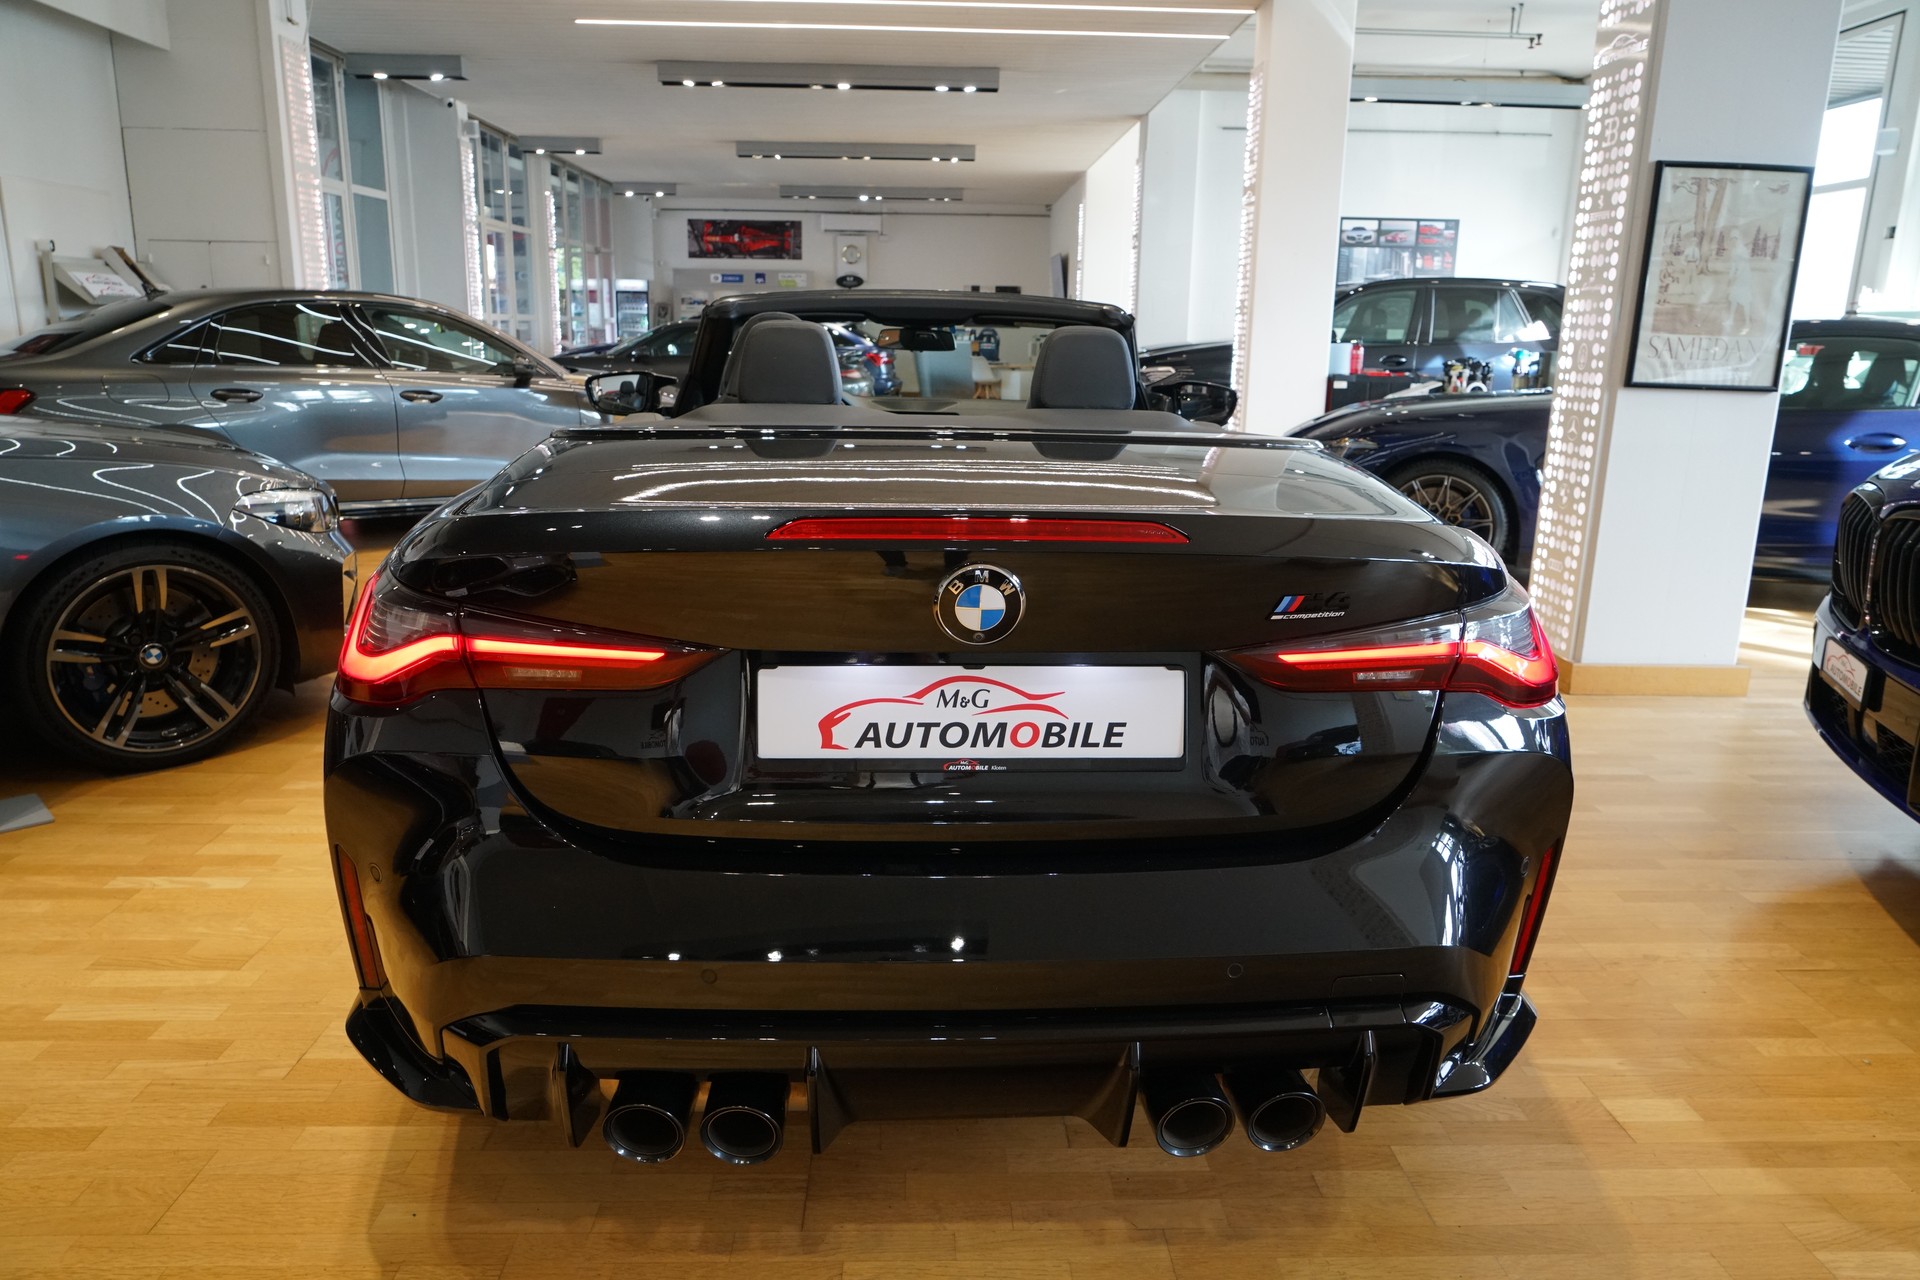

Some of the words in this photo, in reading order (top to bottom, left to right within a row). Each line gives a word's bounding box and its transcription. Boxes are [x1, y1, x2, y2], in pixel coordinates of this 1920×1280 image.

[947, 569, 1016, 596] BMW
[1283, 611, 1345, 620] competition
[936, 688, 990, 709] M&G
[854, 721, 1127, 749] AUTOMOBILE
